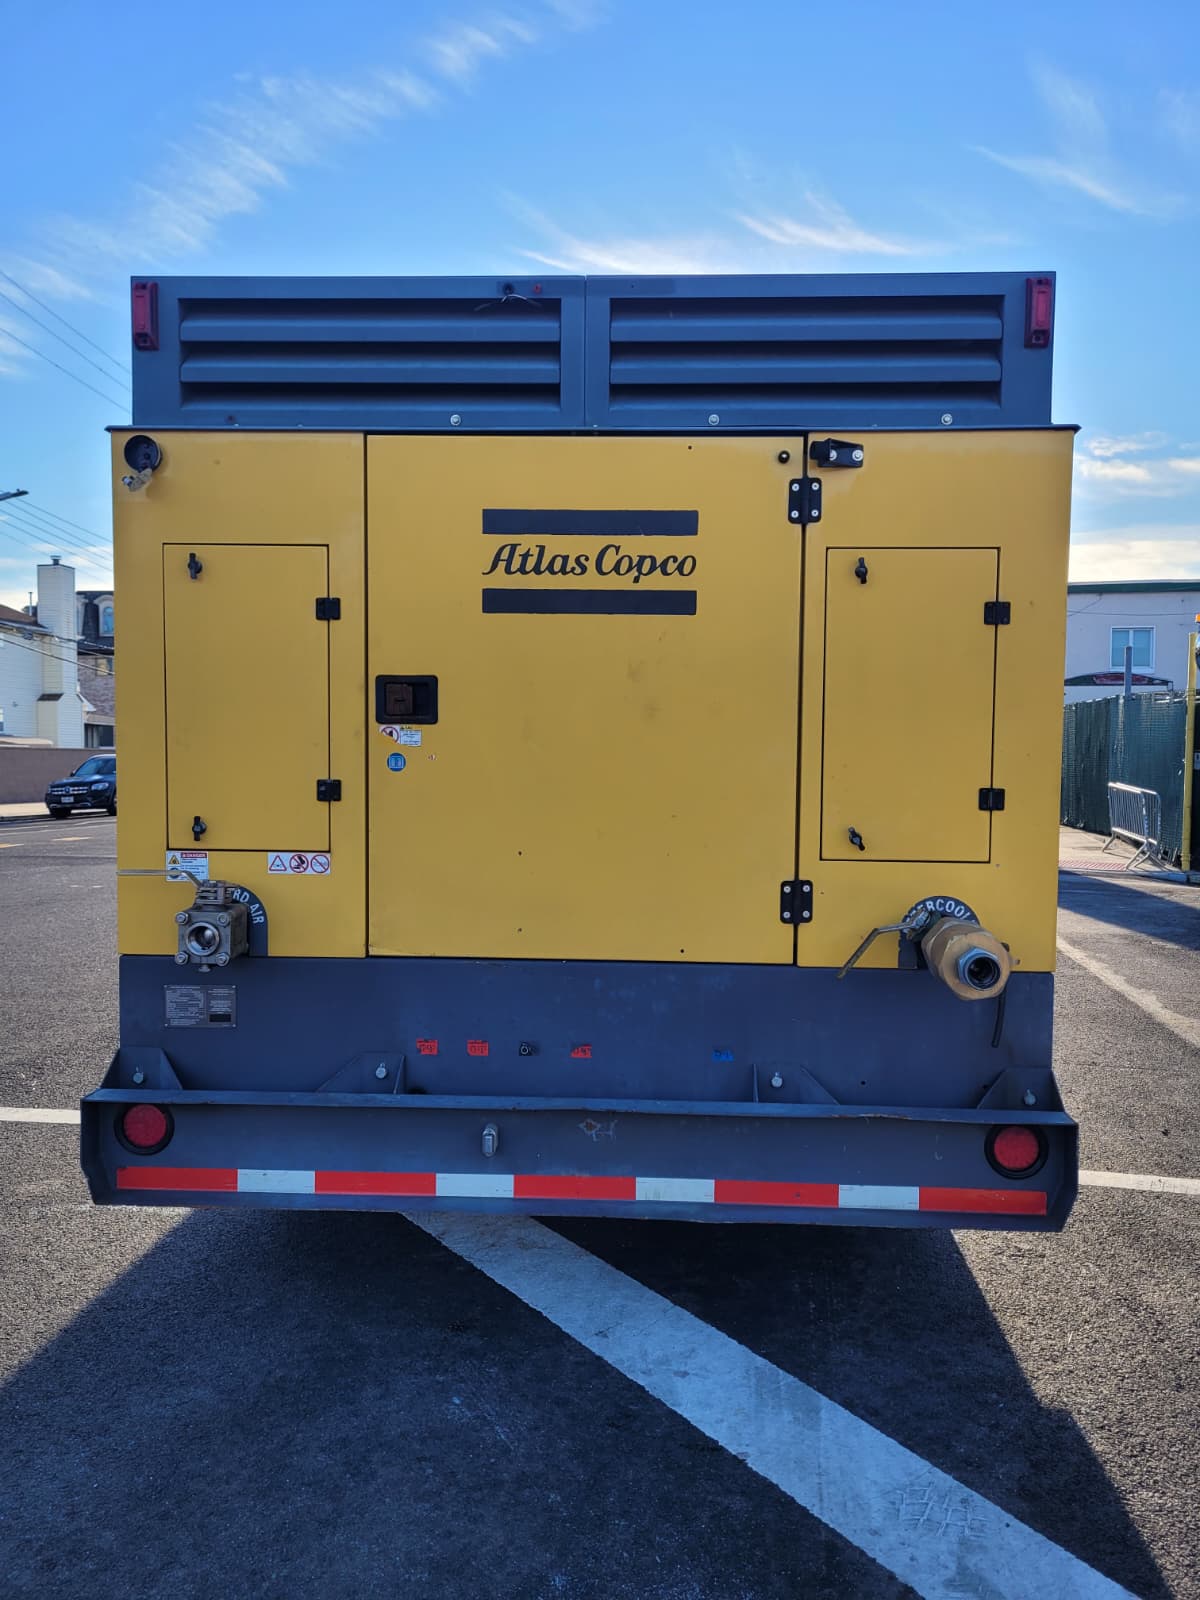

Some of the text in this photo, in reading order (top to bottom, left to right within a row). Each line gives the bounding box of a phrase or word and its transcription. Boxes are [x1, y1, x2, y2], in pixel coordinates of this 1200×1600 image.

[482, 543, 697, 584] Atlas Copco
[250, 903, 265, 924] AIR
